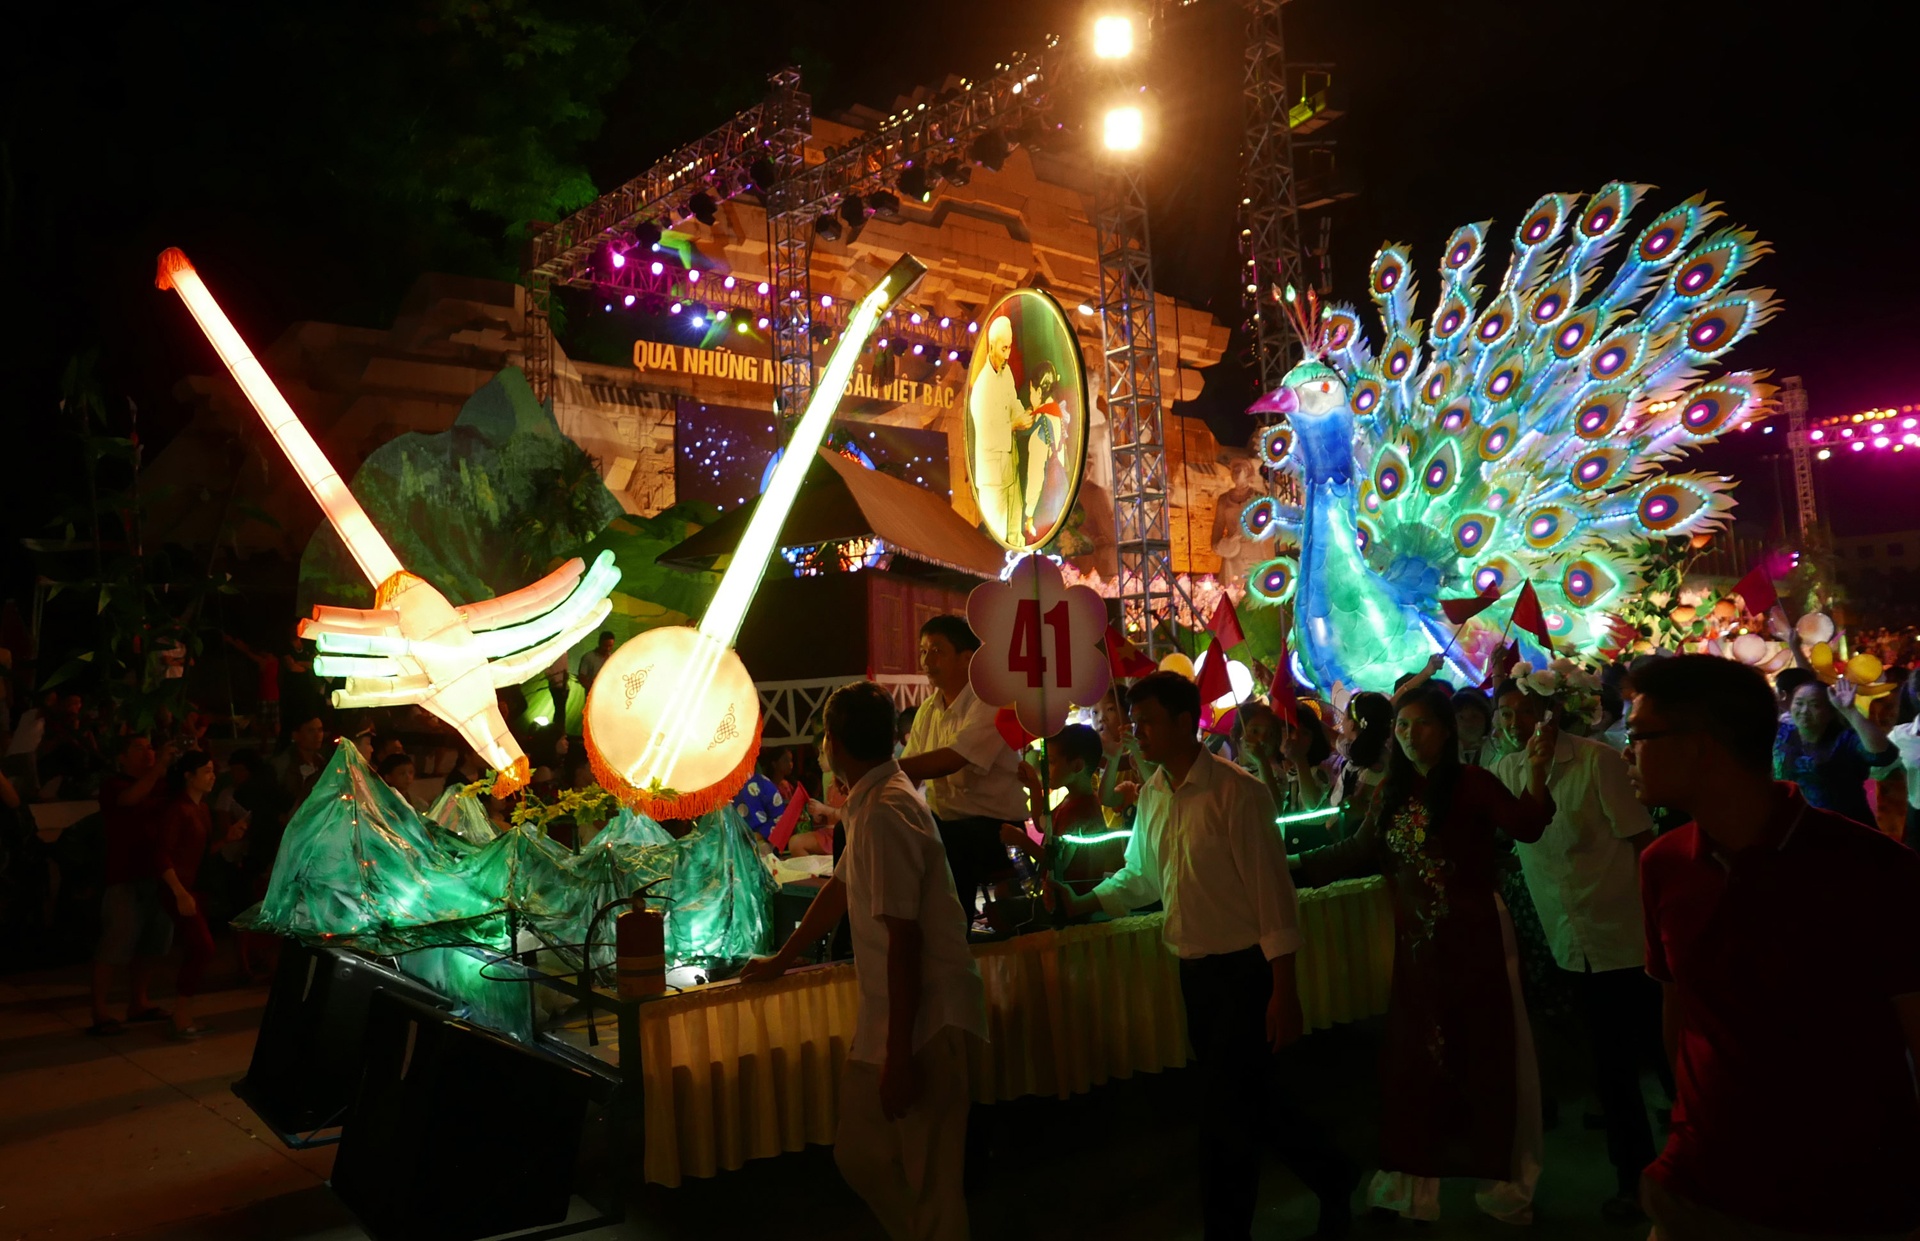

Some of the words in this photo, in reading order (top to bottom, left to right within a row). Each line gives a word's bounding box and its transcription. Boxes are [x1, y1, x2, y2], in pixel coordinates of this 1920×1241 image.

[633, 339, 677, 372] QUA
[683, 346, 758, 382] NHỮNG
[1008, 599, 1072, 688] 41
